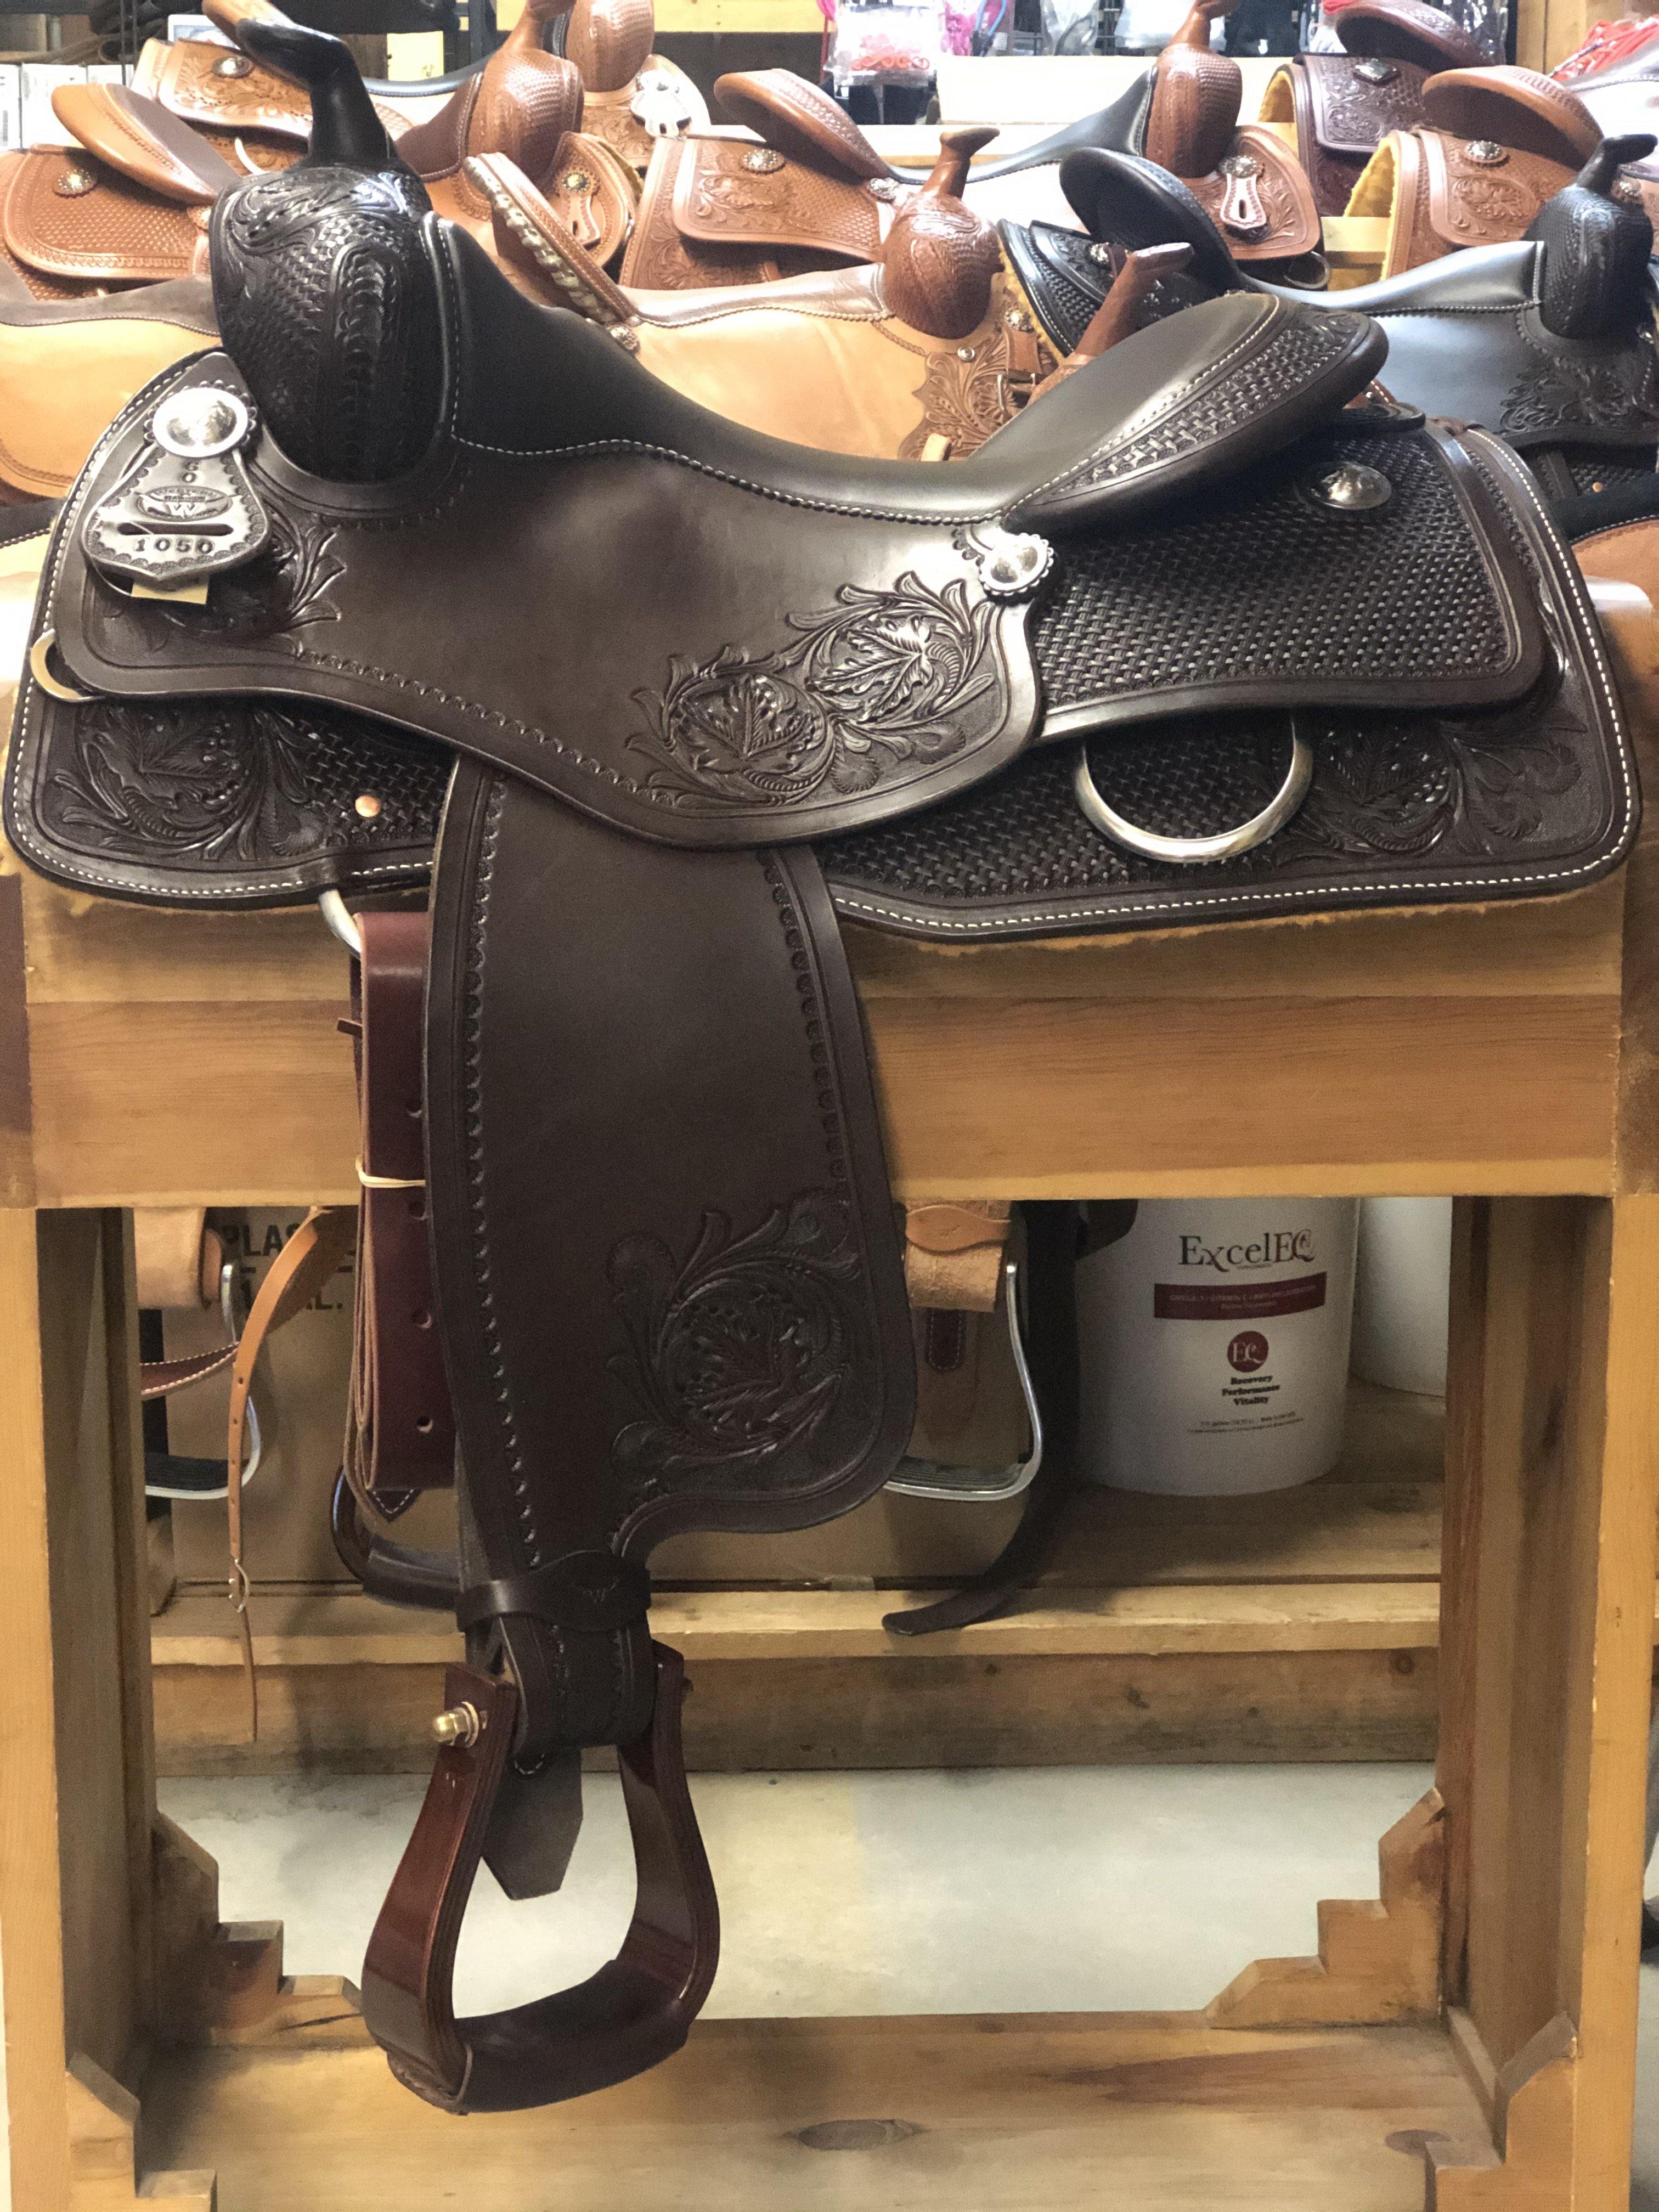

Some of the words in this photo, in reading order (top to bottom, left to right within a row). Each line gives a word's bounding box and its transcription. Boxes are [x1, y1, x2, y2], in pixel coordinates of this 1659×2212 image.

[135, 537, 213, 554] 1050
[1231, 1375, 1273, 1385] Recovery
[1222, 1385, 1280, 1396] Performance
[1234, 1396, 1268, 1406] Vitality
